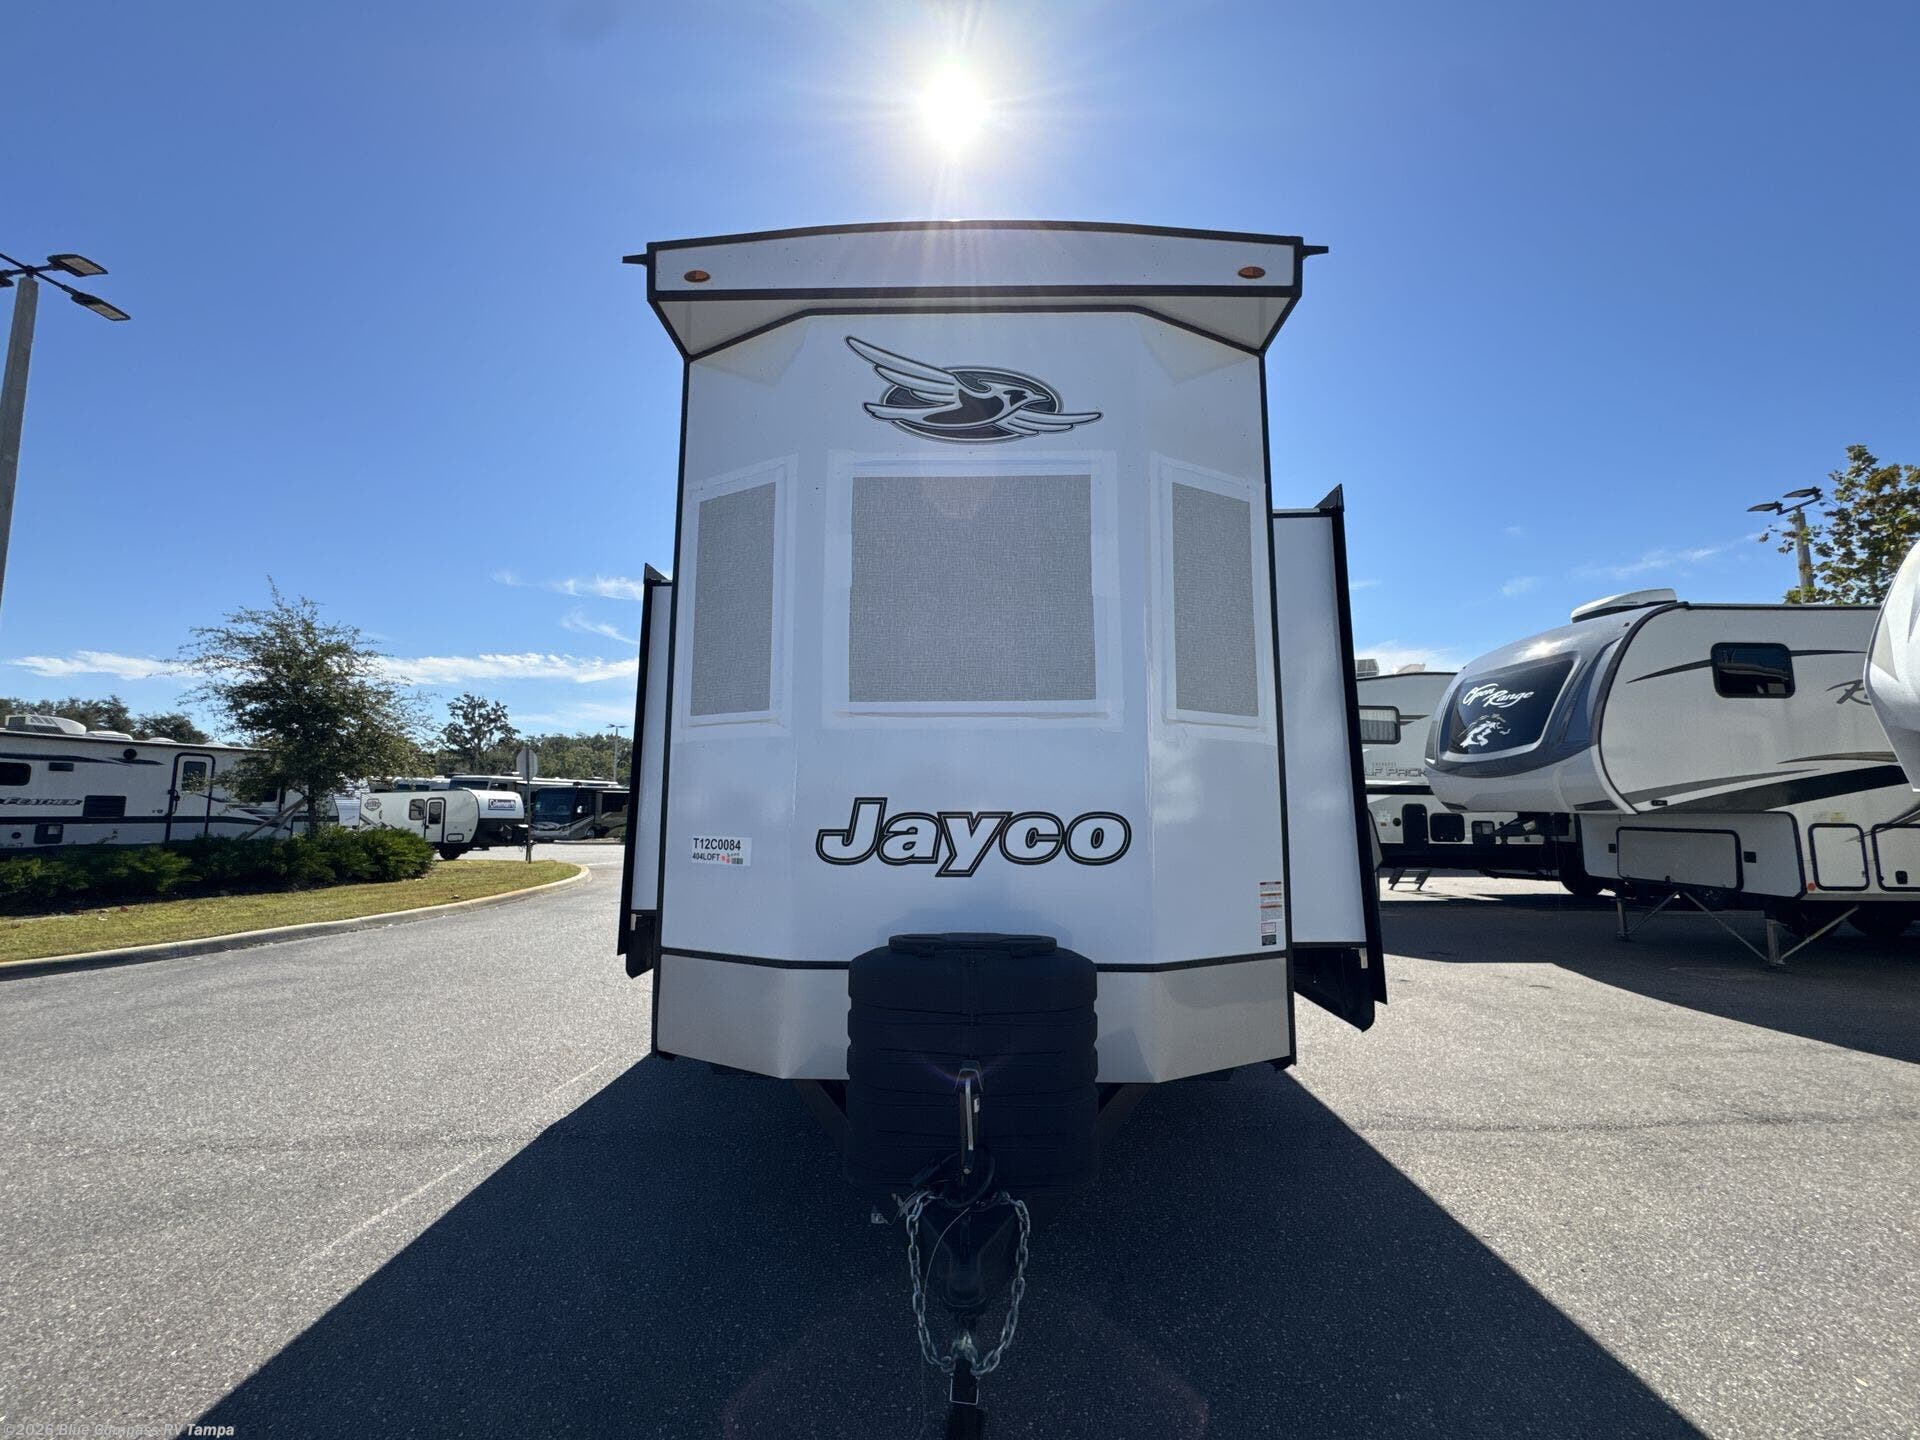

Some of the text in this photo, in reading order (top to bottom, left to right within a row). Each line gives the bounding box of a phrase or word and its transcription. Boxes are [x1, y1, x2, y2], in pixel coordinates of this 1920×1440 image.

[1462, 683, 1535, 708] Open Range
[693, 837, 741, 851] T12C0084
[815, 797, 1132, 878] Jayco
